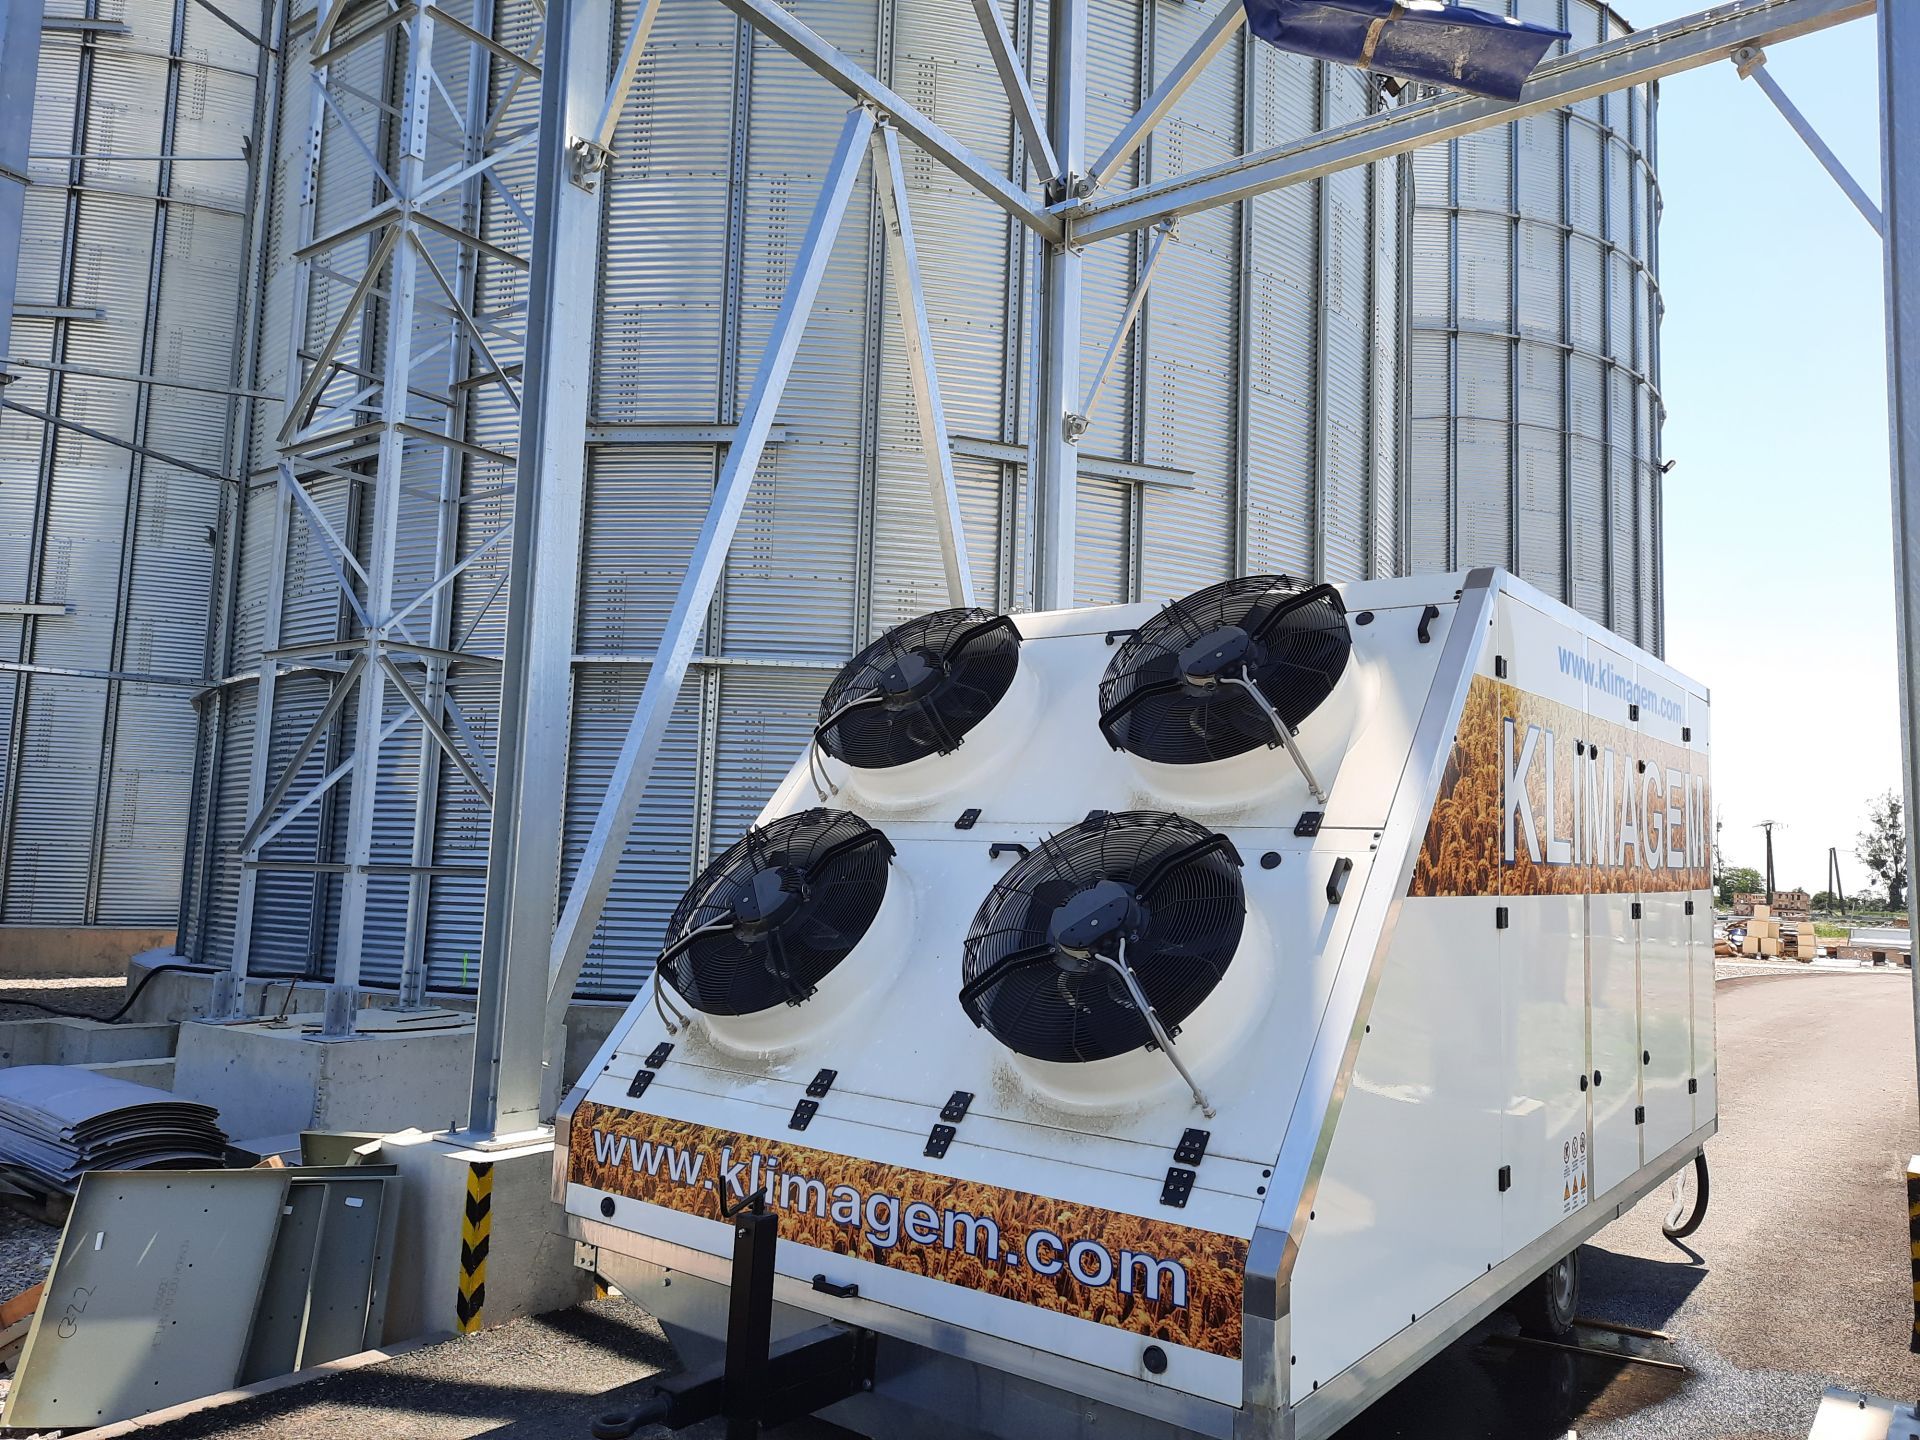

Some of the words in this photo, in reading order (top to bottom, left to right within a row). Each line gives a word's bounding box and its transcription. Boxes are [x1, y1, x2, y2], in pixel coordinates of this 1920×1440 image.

[1558, 646, 1682, 724] www.klimagem.com
[1503, 717, 1705, 869] KLIMAGEM
[592, 1128, 1190, 1307] www.klimagem.com
